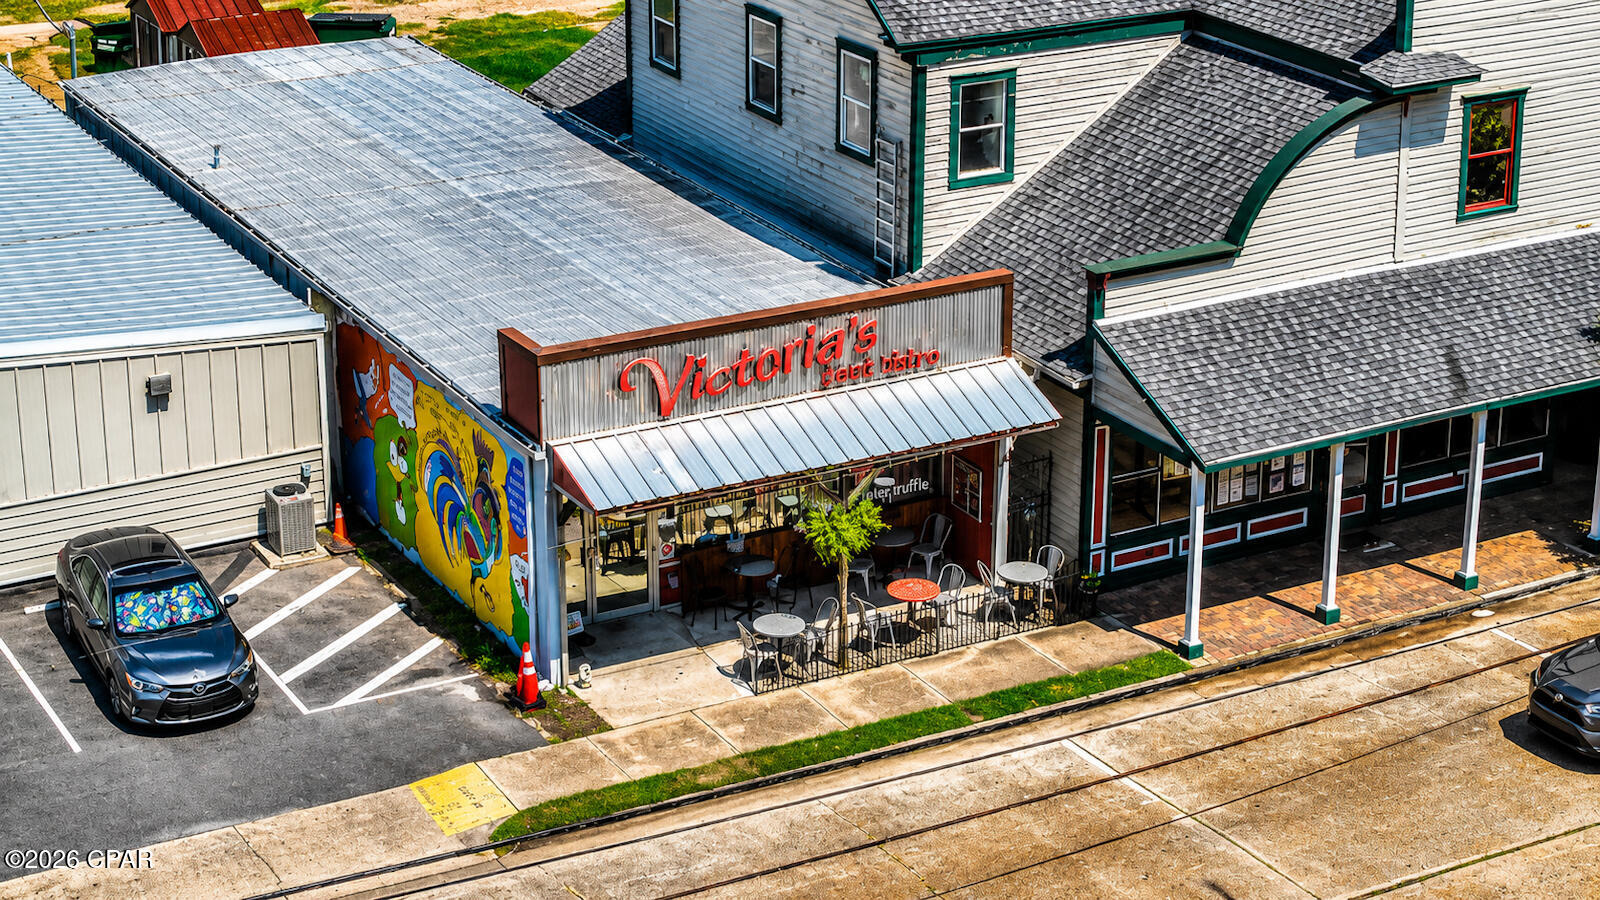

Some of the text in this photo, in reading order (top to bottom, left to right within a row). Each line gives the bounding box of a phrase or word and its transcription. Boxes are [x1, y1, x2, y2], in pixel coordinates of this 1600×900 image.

[618, 314, 878, 417] Victoria's
[880, 347, 940, 373] bistro
[893, 478, 929, 495] truffle
